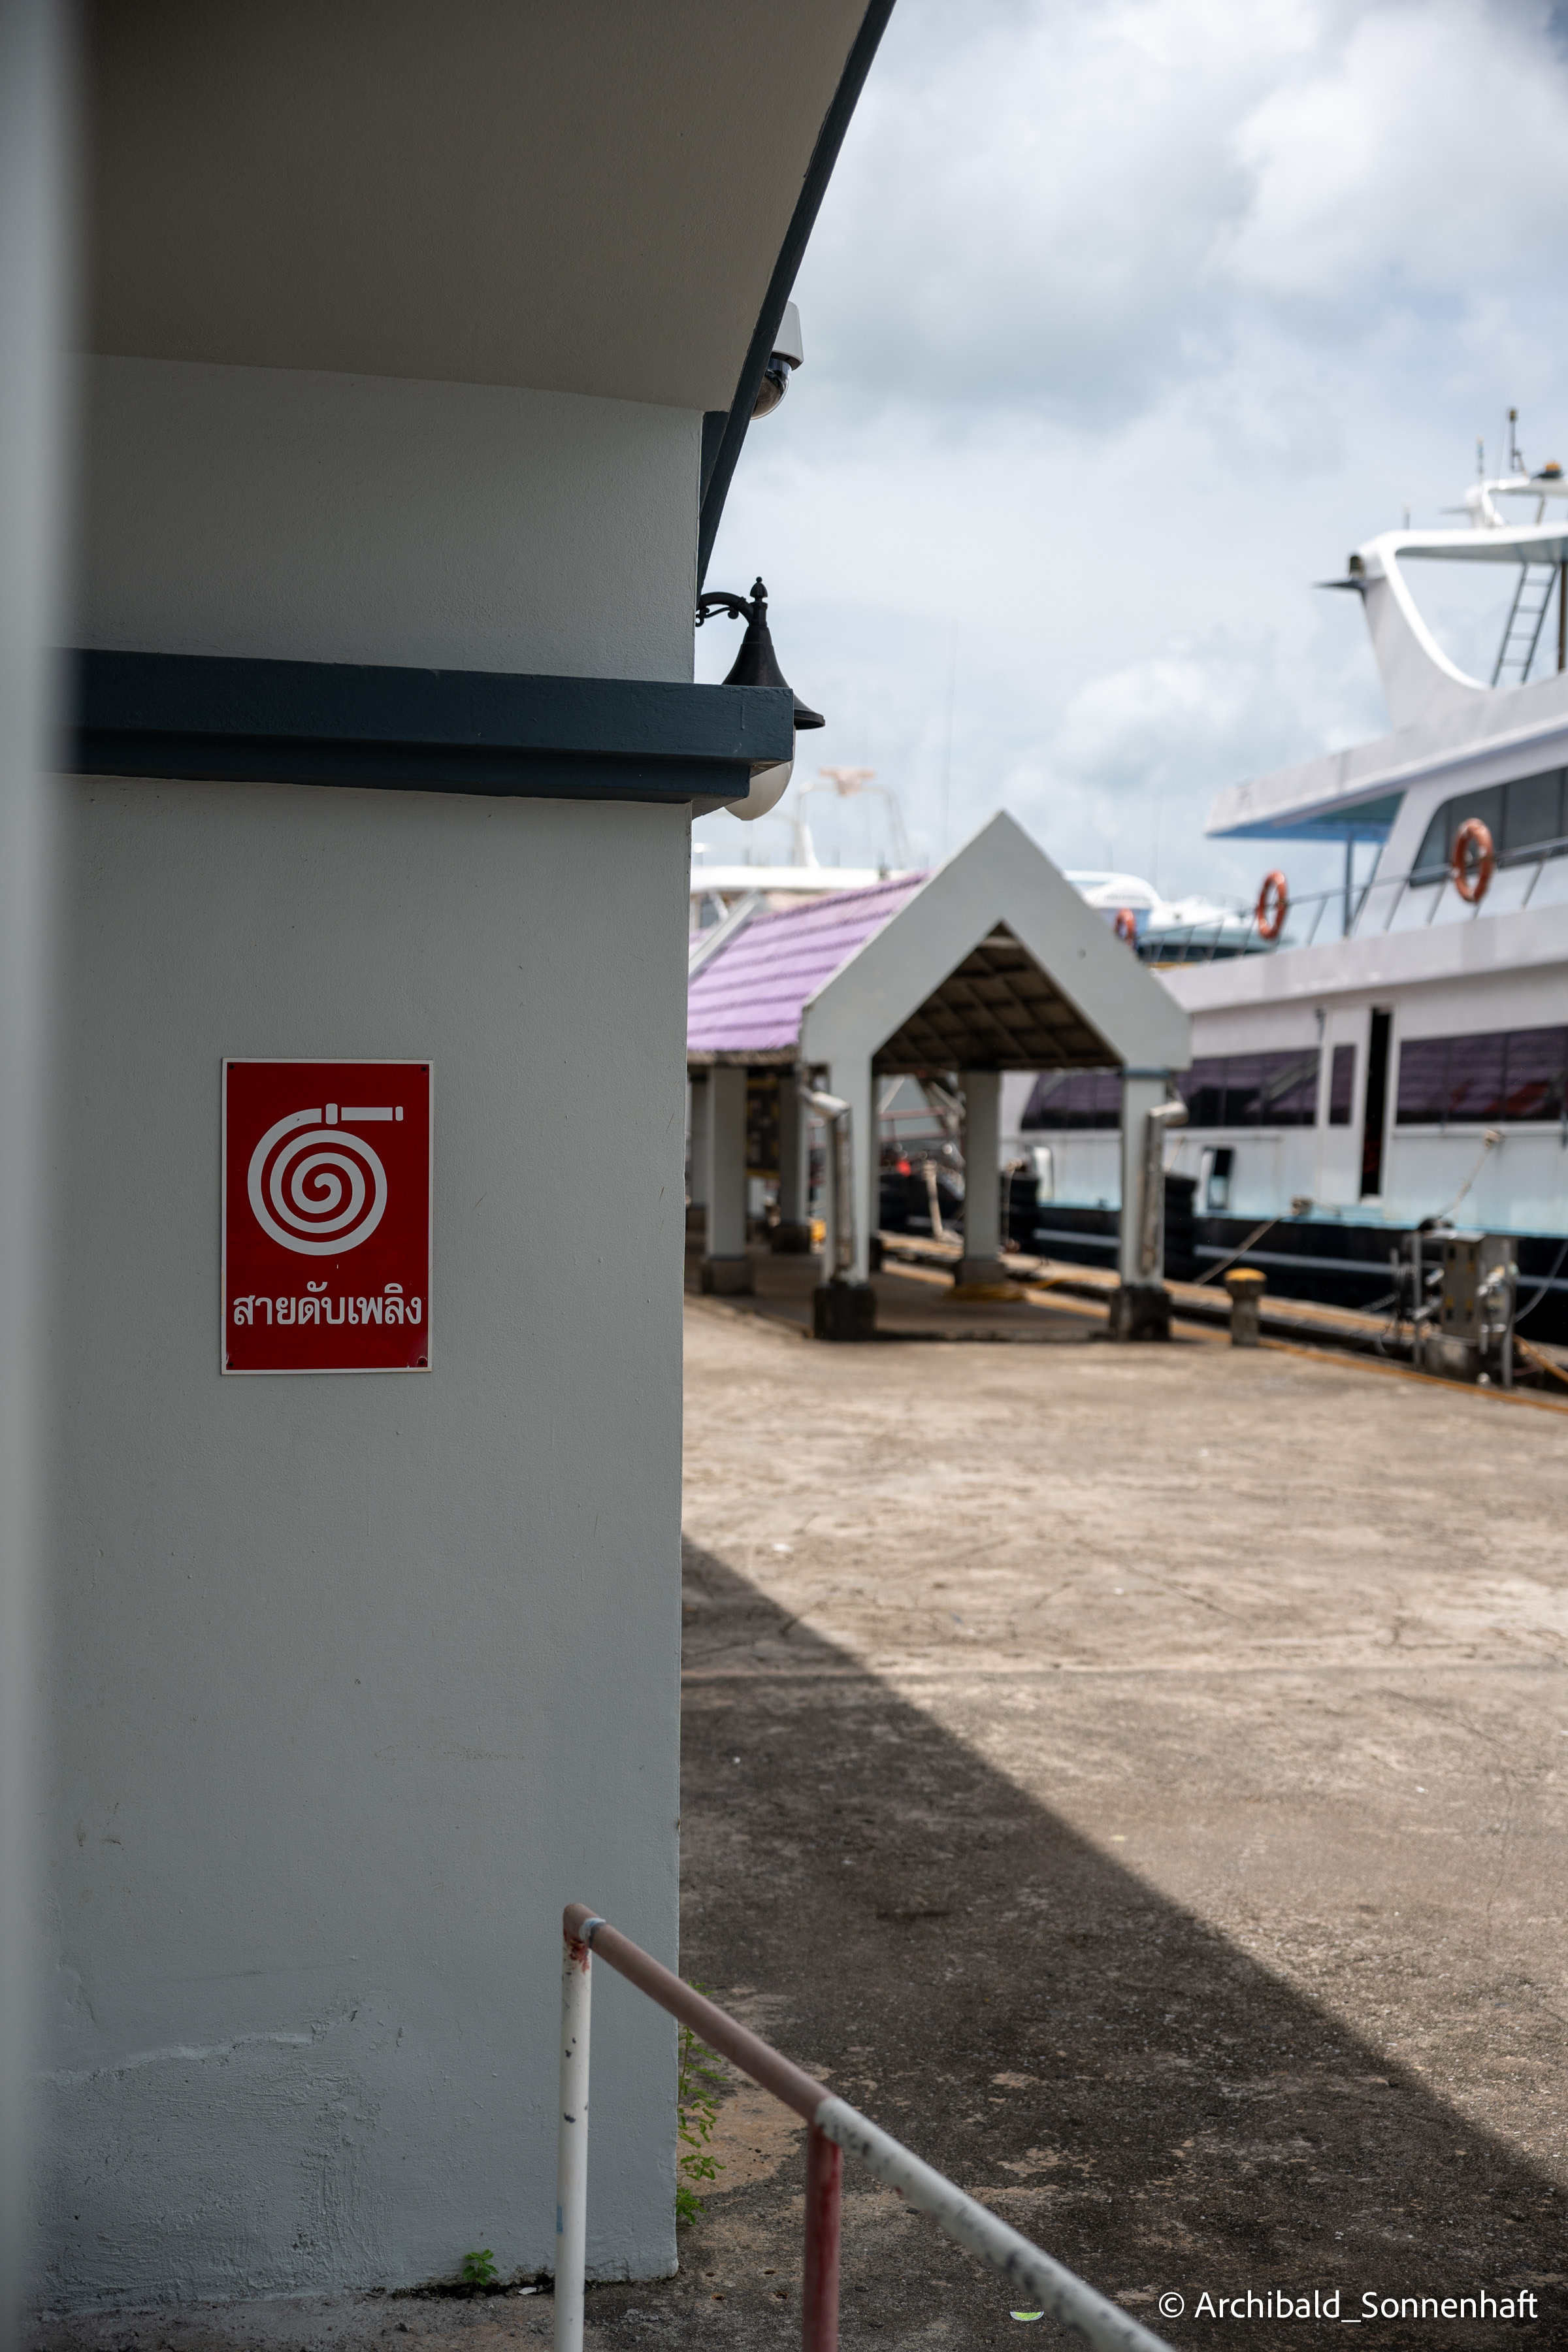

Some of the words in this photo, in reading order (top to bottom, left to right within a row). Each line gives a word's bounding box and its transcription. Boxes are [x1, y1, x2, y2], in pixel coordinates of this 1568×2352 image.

[233, 1281, 422, 1325] สายดับเพลิง
